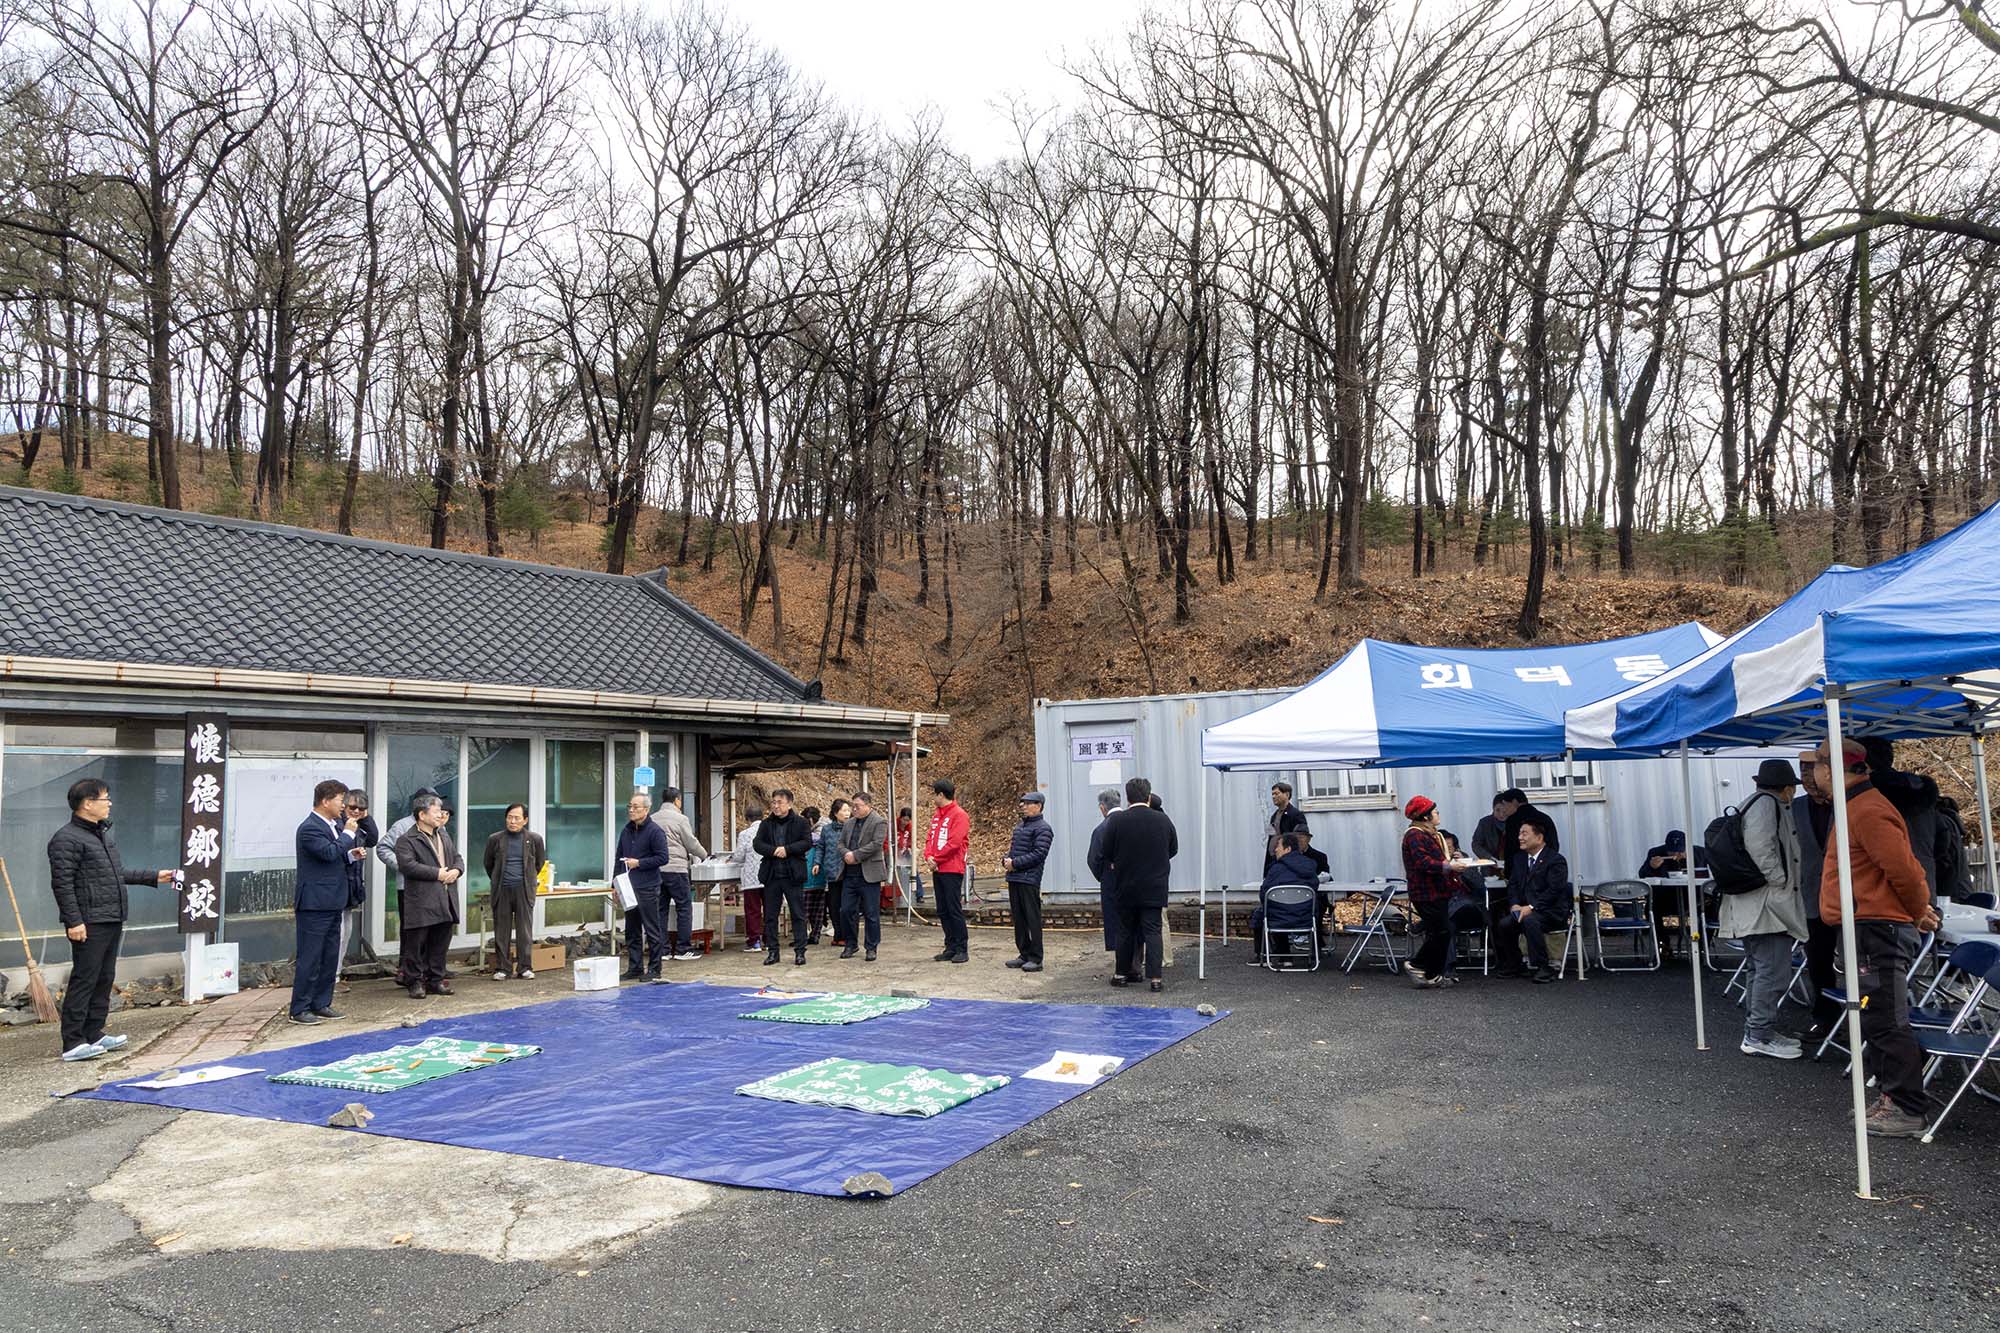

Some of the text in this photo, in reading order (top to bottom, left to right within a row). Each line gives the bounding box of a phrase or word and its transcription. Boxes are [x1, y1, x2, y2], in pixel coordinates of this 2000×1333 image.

[1079, 741, 1127, 756] 圖書室
[942, 818, 950, 826] 2
